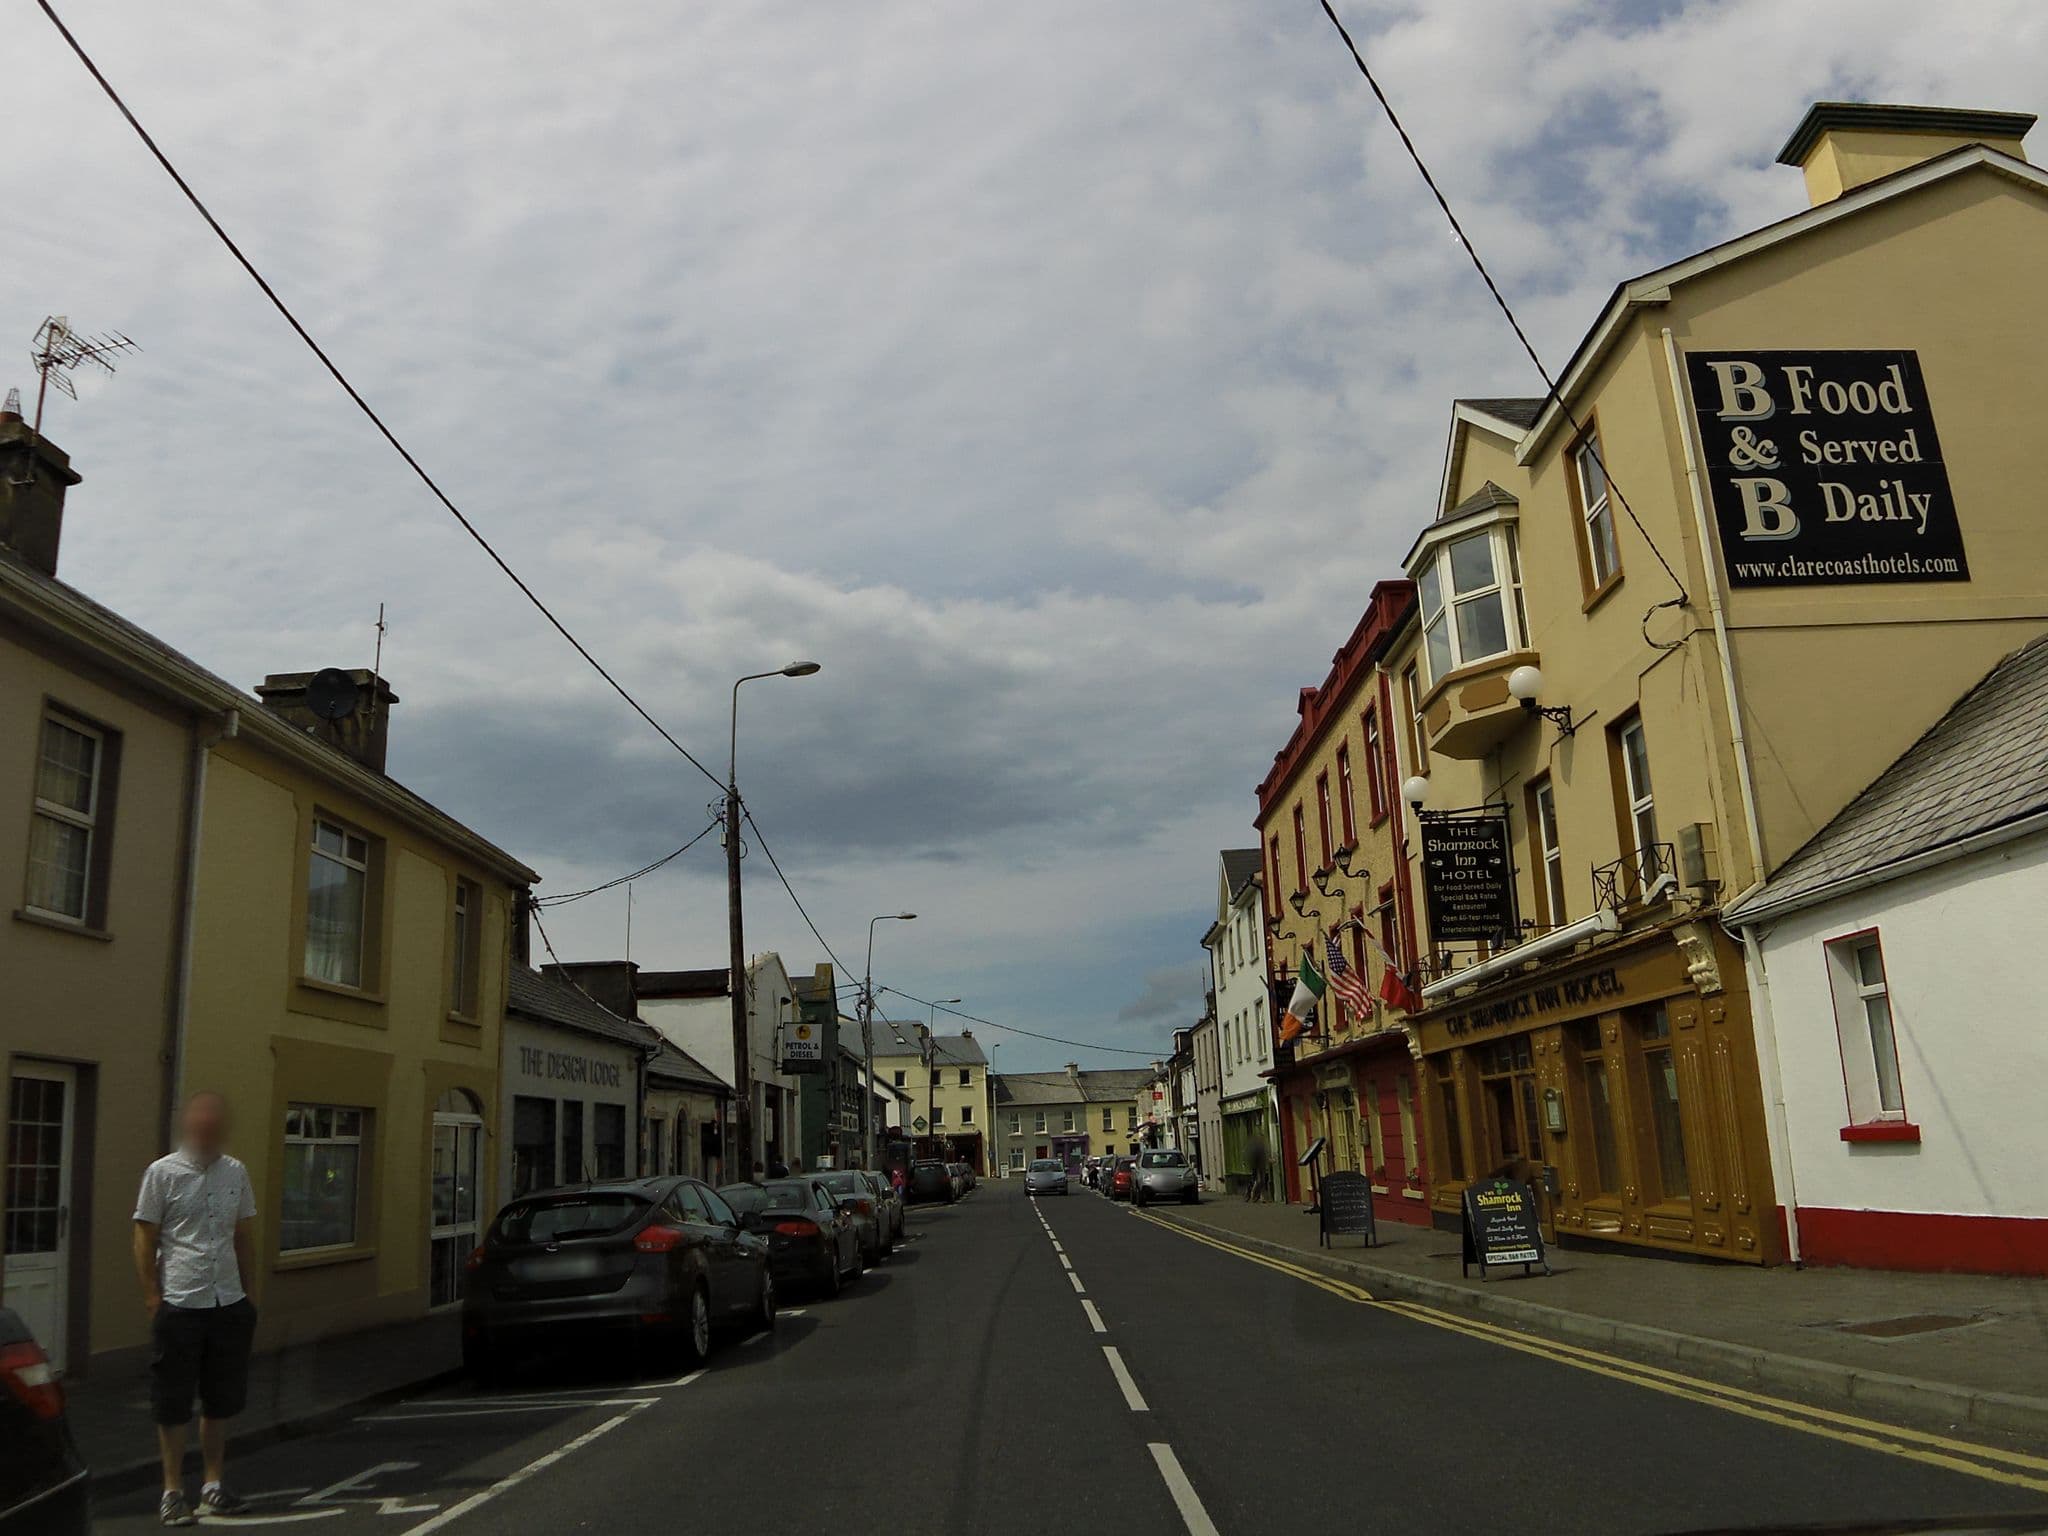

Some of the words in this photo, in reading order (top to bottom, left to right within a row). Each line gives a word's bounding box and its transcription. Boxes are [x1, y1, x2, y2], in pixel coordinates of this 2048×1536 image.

[1706, 360, 1776, 422] B
[1781, 364, 1913, 416] Food
[1728, 425, 1781, 471] &
[1799, 428, 1924, 466] Served
[1730, 477, 1801, 542] B
[1818, 479, 1932, 536] Daily
[1735, 552, 1959, 579] www.clarecoasthotels.com
[1448, 827, 1479, 837] THE
[1441, 869, 1493, 881] HOTEL
[1455, 853, 1477, 867] Inn
[1463, 883, 1484, 891] Served
[520, 1046, 543, 1078] THE
[547, 1052, 587, 1084] DESIGN
[590, 1059, 621, 1088] LODGE
[1477, 1192, 1522, 1206] Shamrock
[1505, 1203, 1522, 1212] Inn
